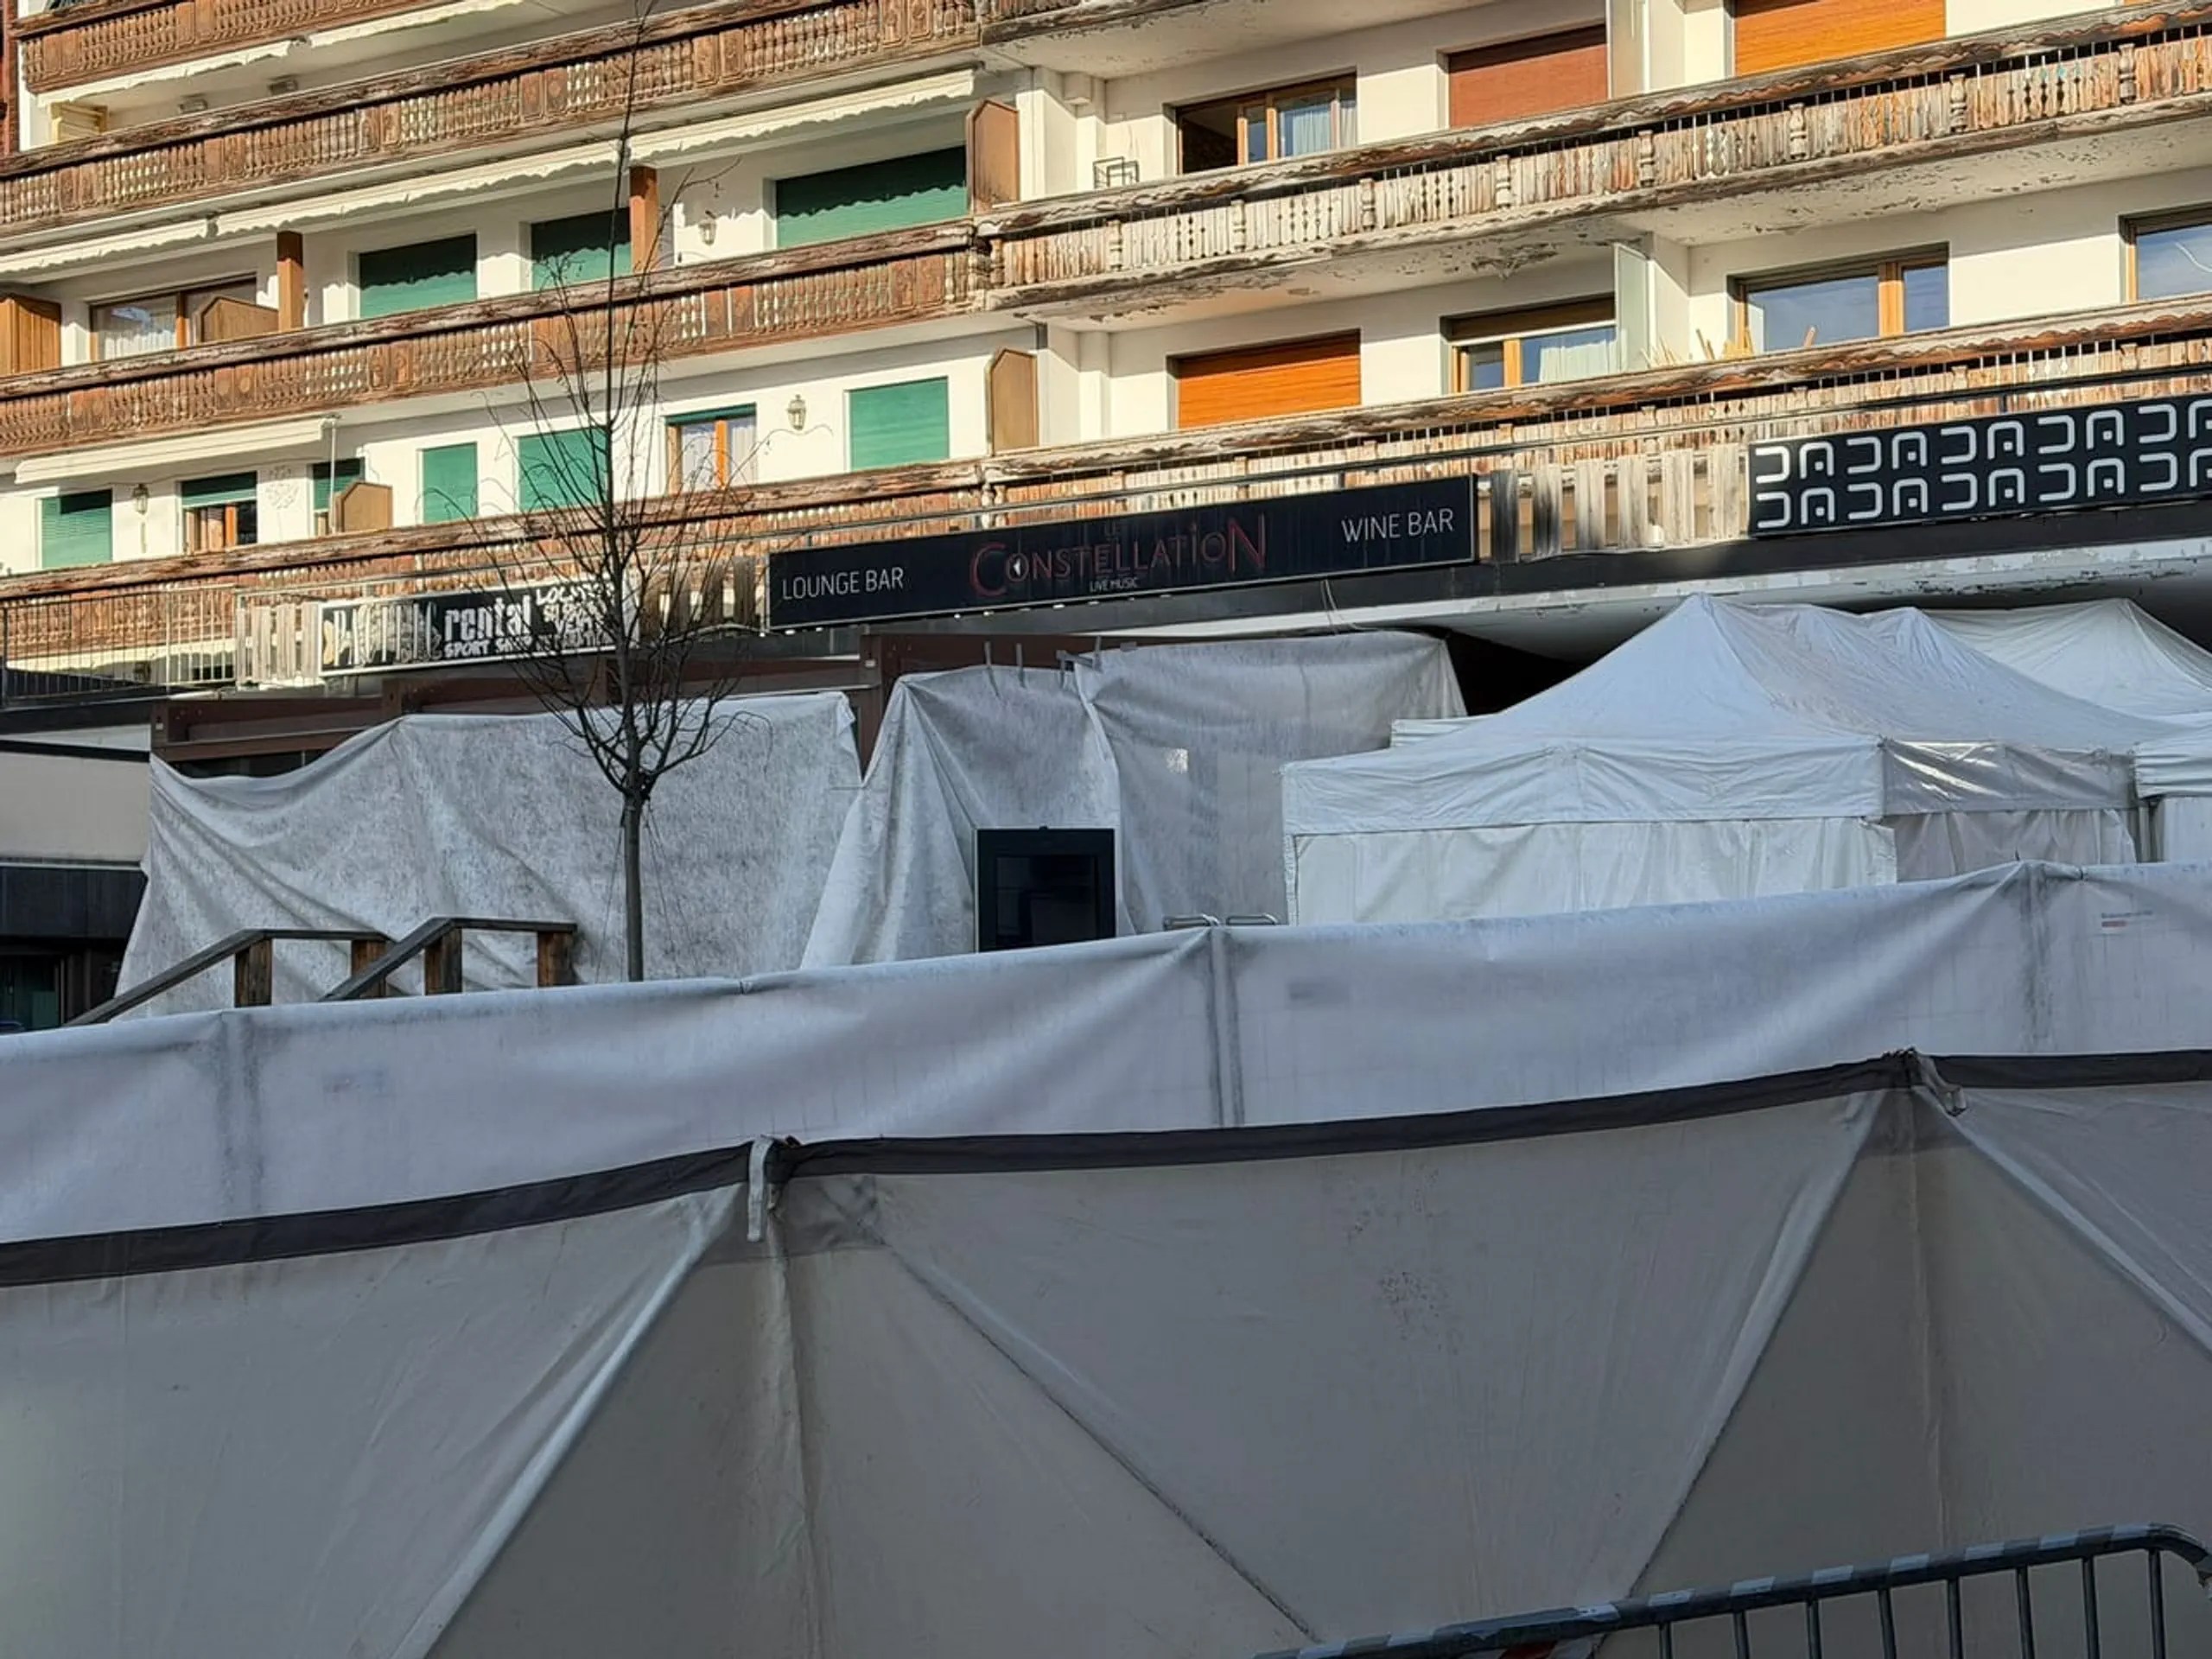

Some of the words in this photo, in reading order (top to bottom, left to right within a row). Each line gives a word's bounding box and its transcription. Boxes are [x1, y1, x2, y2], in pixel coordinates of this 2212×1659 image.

[1341, 513, 1401, 543] WINE
[1408, 508, 1453, 537] BAR
[782, 571, 861, 600] LOUNGE
[865, 567, 904, 592] BAR
[444, 594, 531, 641] rental
